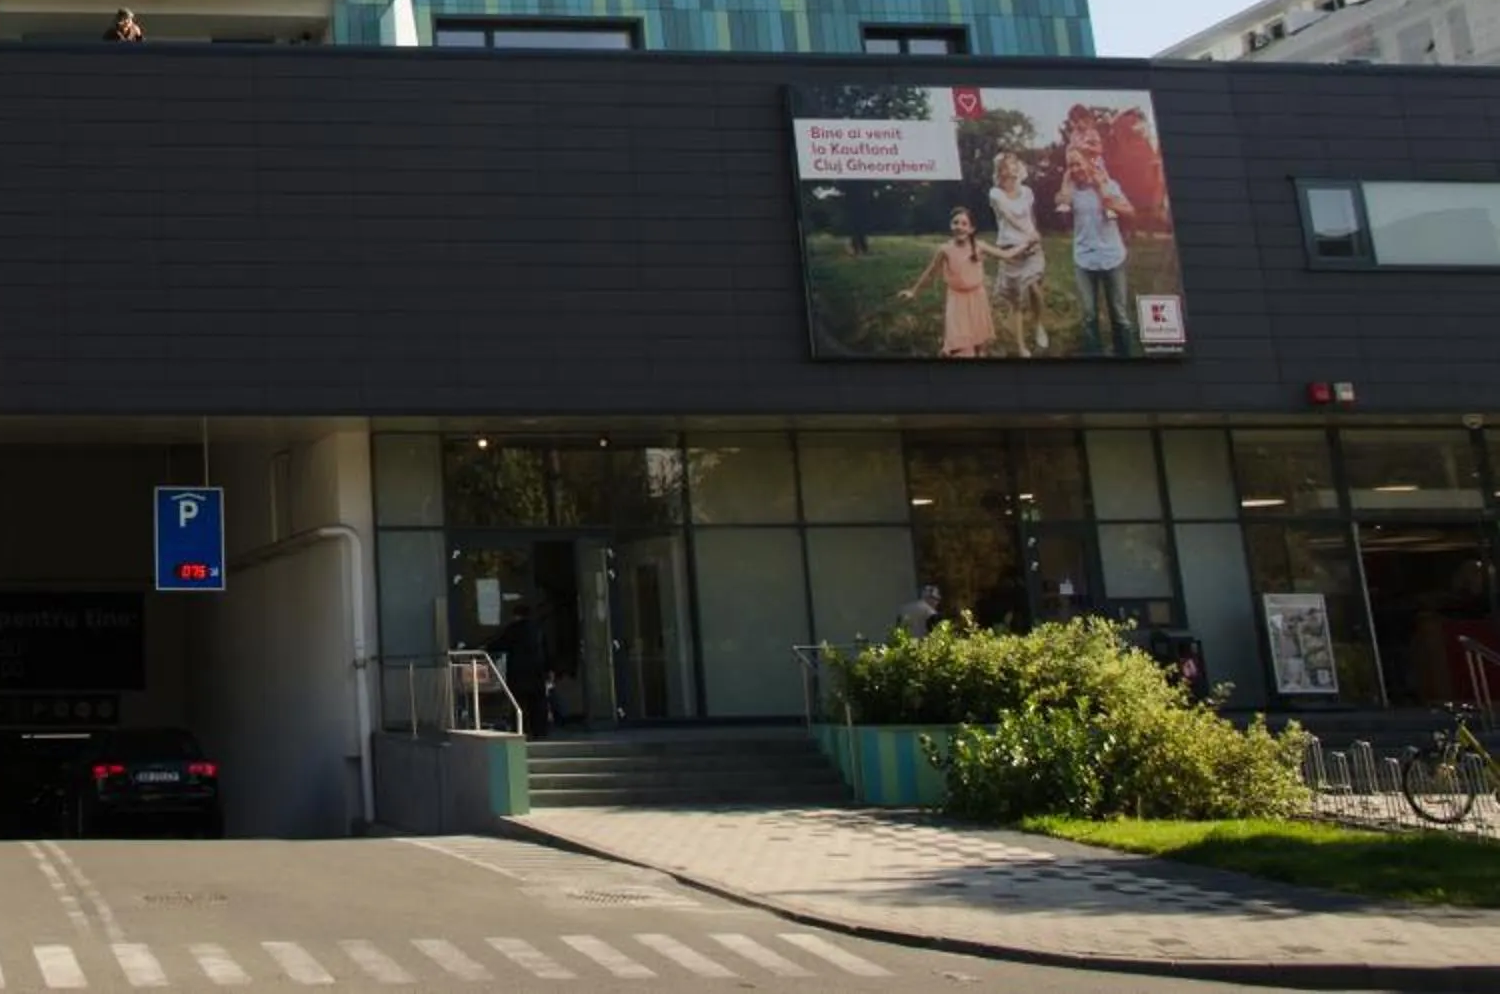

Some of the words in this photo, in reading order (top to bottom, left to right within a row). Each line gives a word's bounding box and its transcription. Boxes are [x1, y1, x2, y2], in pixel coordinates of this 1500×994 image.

[810, 126, 843, 140] Bine
[847, 126, 861, 140] ai
[865, 127, 903, 141] venit
[811, 143, 826, 155] la
[830, 143, 899, 156] Kaufland
[813, 159, 843, 174] Cluj
[179, 500, 199, 528] P
